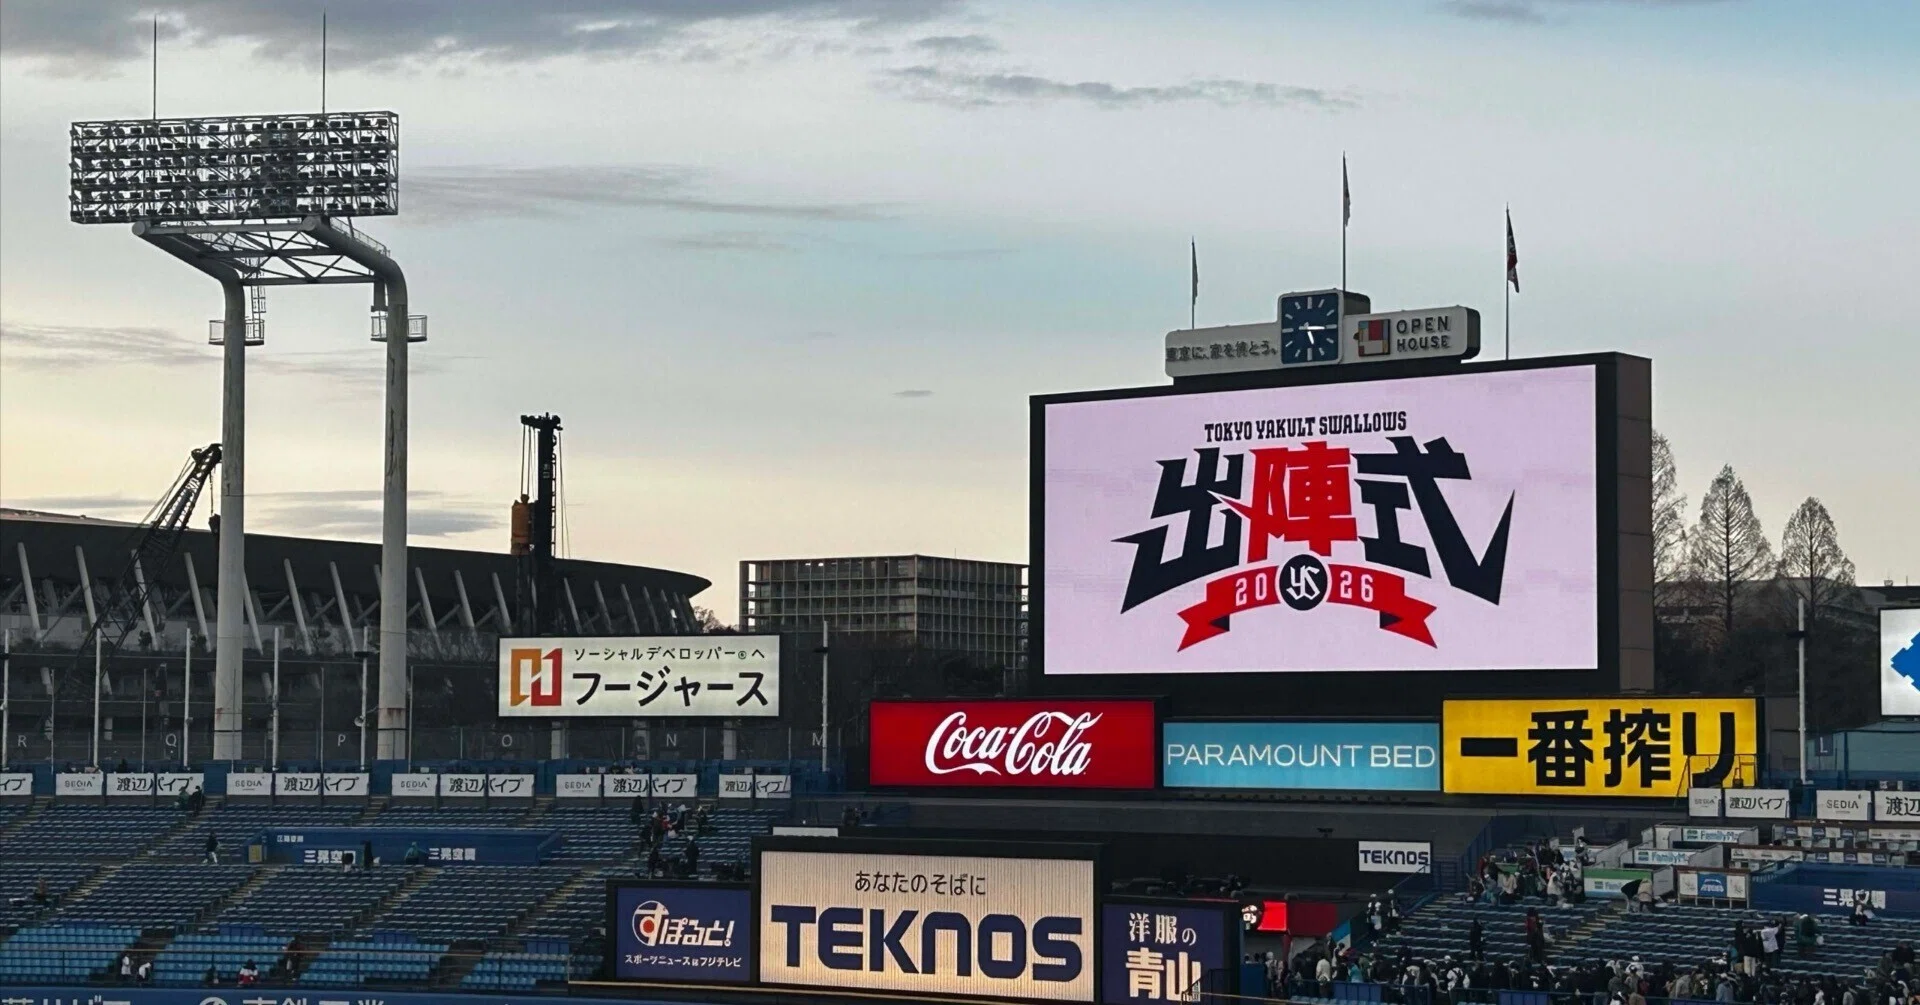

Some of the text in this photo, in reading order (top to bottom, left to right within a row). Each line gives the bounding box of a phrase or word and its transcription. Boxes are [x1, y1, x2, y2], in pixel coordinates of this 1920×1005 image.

[1396, 315, 1449, 334] OPEN
[1396, 335, 1450, 352] HOUSE
[1204, 411, 1407, 442] TOKYO YAKULT SWALLOWS
[1111, 436, 1515, 615] 出陣式
[573, 665, 768, 707] フージャース
[925, 711, 1103, 775] Coca-Cola
[1460, 708, 1736, 789] 一番搾り
[1167, 744, 1436, 768] PARAMOUNT BED
[116, 777, 193, 792] 渡辺パイプ
[284, 776, 360, 792] 渡辺パイプ
[449, 777, 525, 793] 渡辺パイプ
[613, 777, 687, 793] 渡辺パイプ
[1729, 796, 1785, 810] 渡辺パイプ
[1826, 800, 1859, 809] SEDIA
[1886, 796, 1920, 816] 渡辺
[1359, 849, 1429, 866] TEKNOS
[855, 870, 987, 896] あなたのそばに
[1128, 912, 1197, 946] 洋服の
[771, 904, 1082, 983] TEKNOS
[1125, 947, 1201, 1002] 青山
